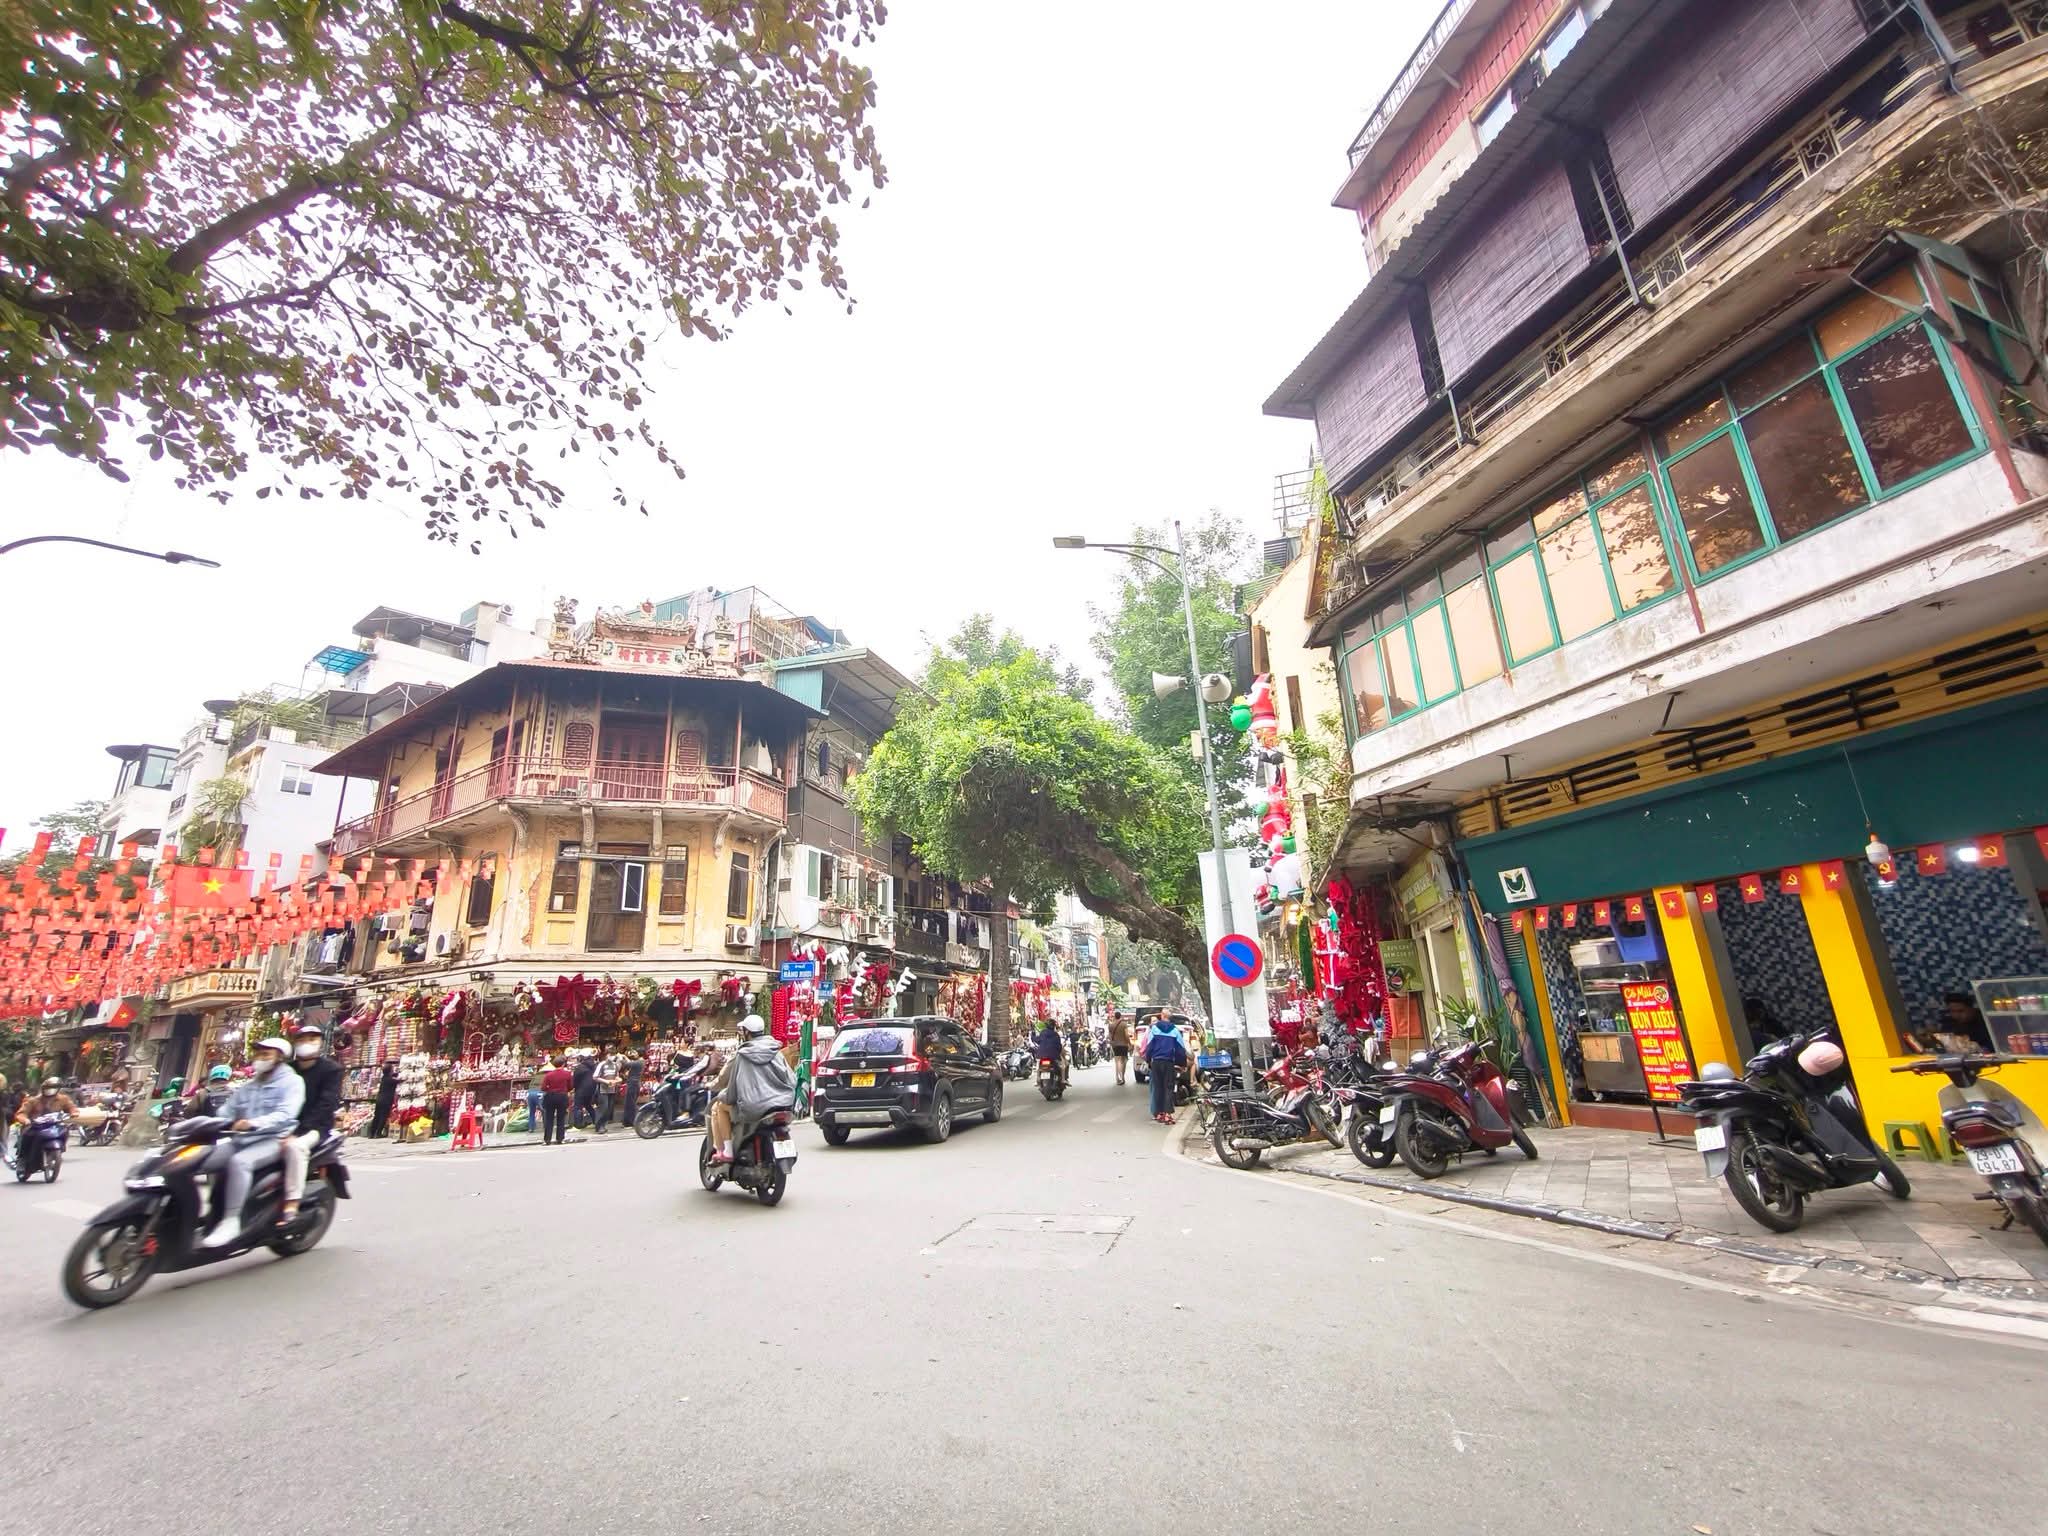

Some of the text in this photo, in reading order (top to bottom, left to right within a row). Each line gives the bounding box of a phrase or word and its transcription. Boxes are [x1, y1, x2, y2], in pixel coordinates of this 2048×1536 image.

[1629, 1006, 1676, 1029] BÚN RIÊU
[1665, 1040, 1688, 1062] CUA
